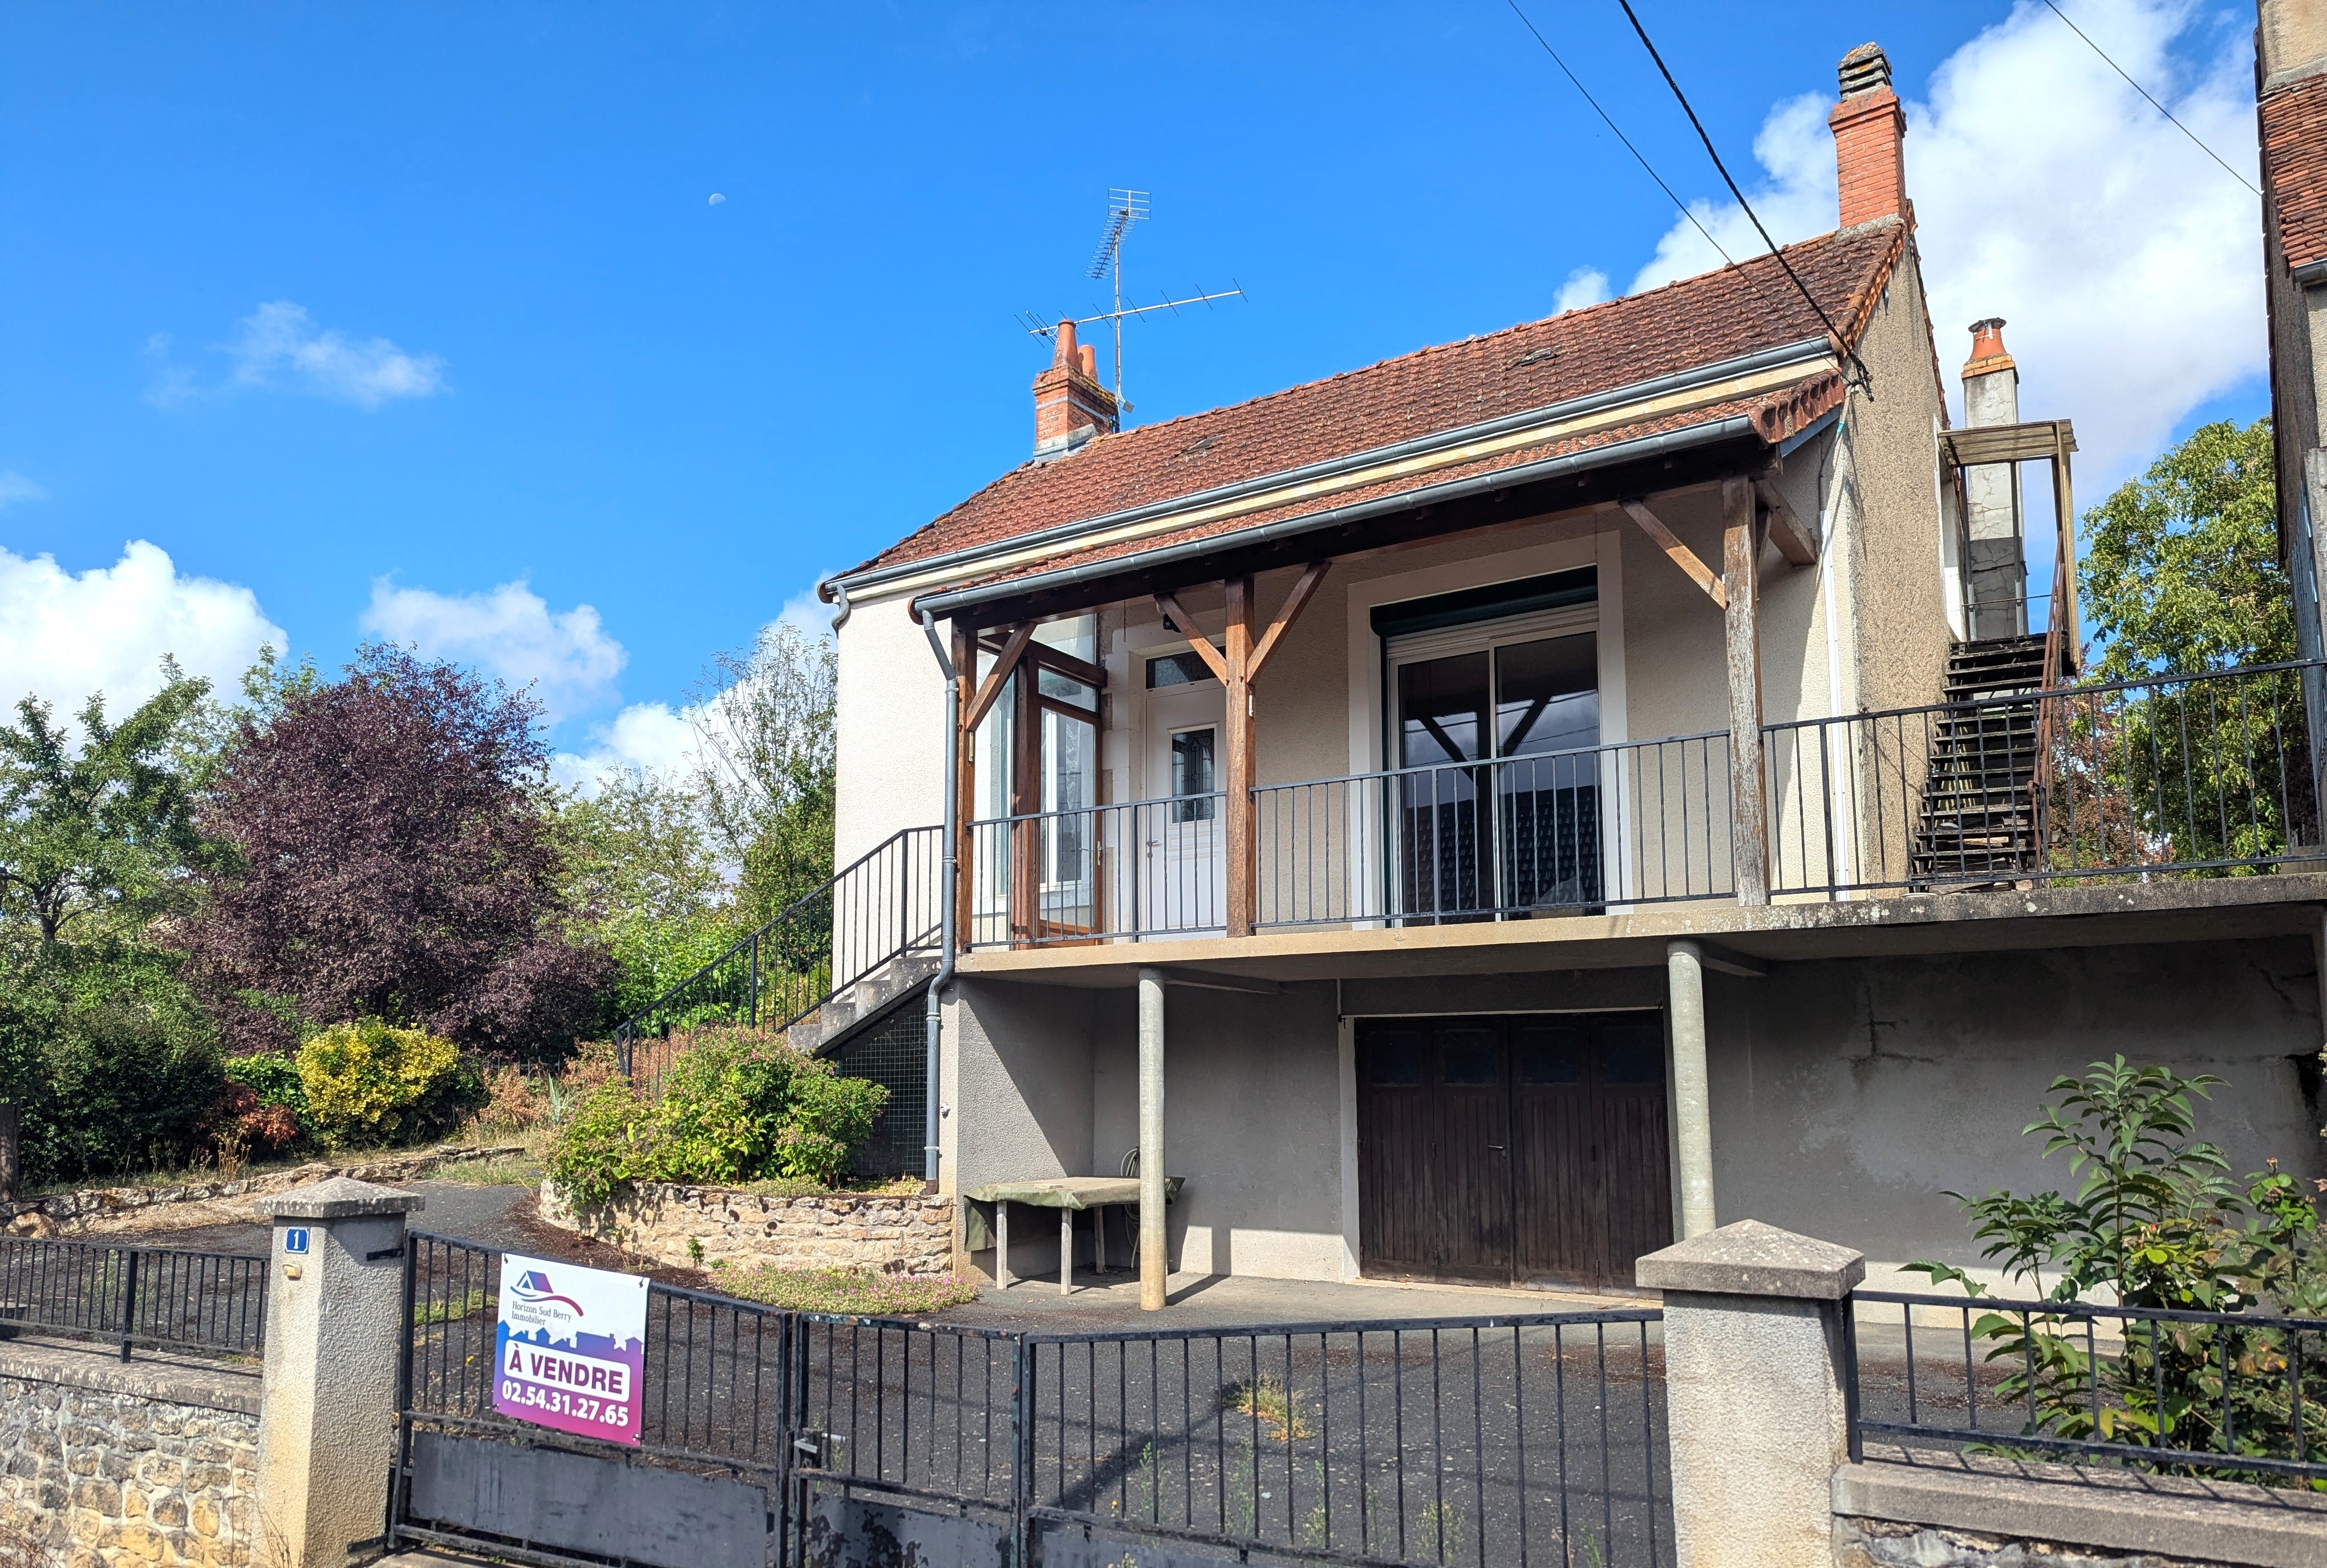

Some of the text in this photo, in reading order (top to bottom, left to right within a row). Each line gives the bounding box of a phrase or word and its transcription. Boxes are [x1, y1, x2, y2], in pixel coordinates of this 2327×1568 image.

[293, 1231, 299, 1249] 1
[512, 1300, 572, 1323] Horizon Sud Berry
[512, 1311, 546, 1326] Immobilier
[509, 1343, 623, 1394] À VENDRE
[502, 1380, 629, 1427] 02.54.31.27.65
